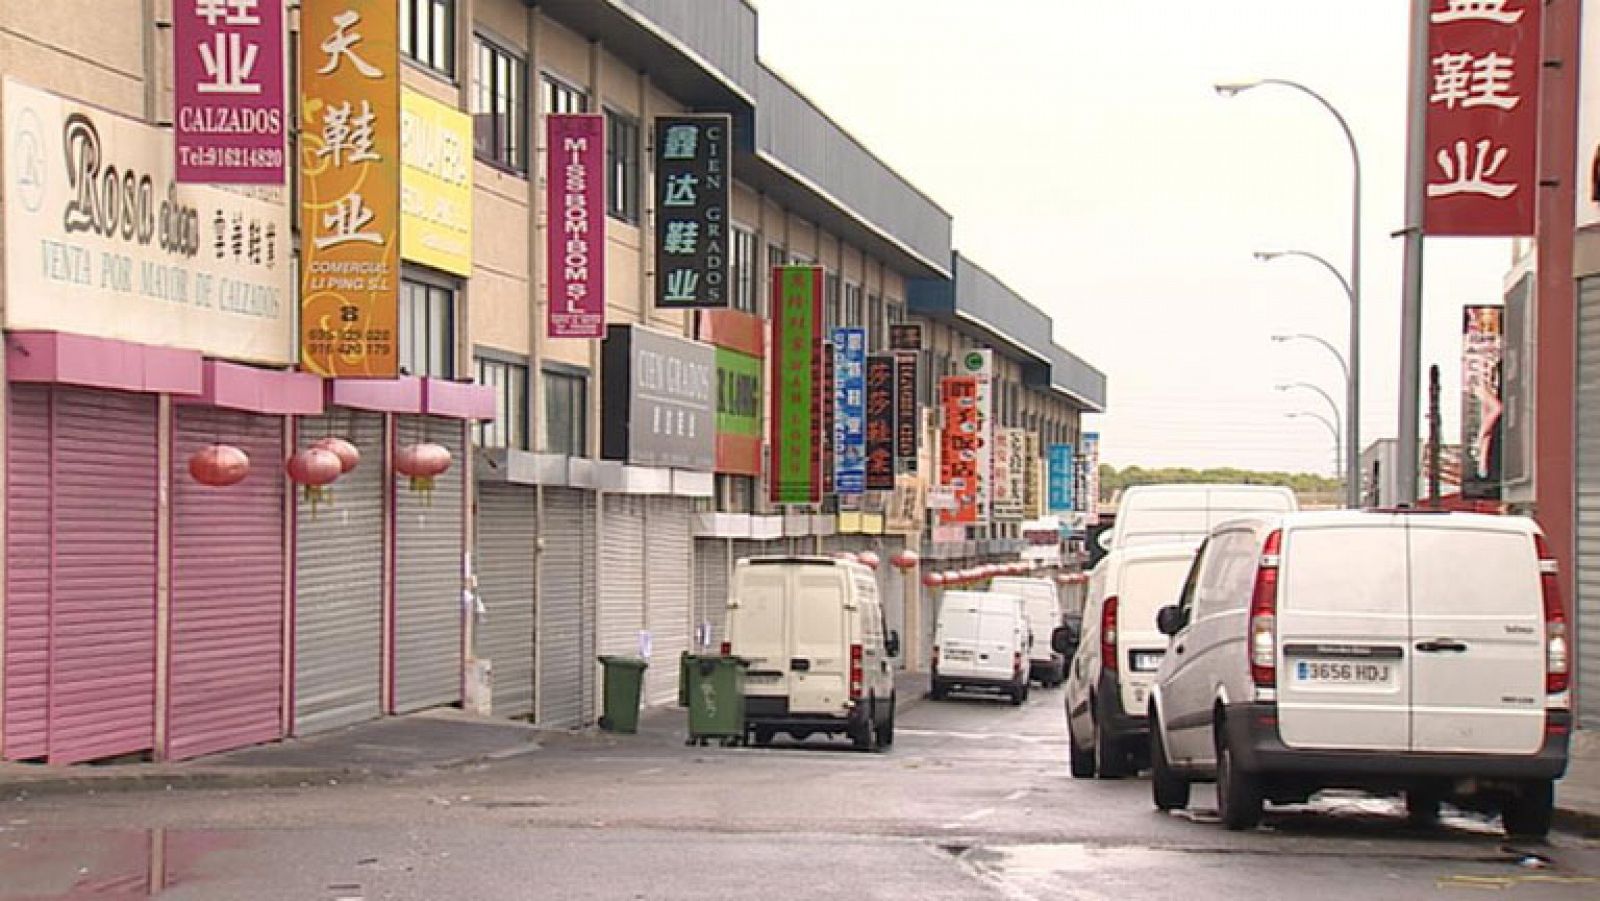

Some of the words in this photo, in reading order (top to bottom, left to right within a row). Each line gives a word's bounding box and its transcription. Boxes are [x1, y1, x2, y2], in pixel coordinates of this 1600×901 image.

[180, 107, 280, 134] CALZADOS
[315, 9, 386, 249] 天鞋业
[706, 126, 722, 189] CIEN
[64, 112, 155, 246] Rosa
[663, 124, 699, 302] 鑫达鞋业
[42, 239, 92, 286] VENTA
[101, 251, 132, 293] POR
[139, 260, 189, 304] MAYOR
[195, 271, 213, 308] DE
[218, 277, 281, 320] CALZADOS
[310, 261, 389, 274] COMERCIAL
[706, 207, 722, 302] GRADOS
[1309, 662, 1352, 680] 3656
[1355, 664, 1389, 682] HDJ
